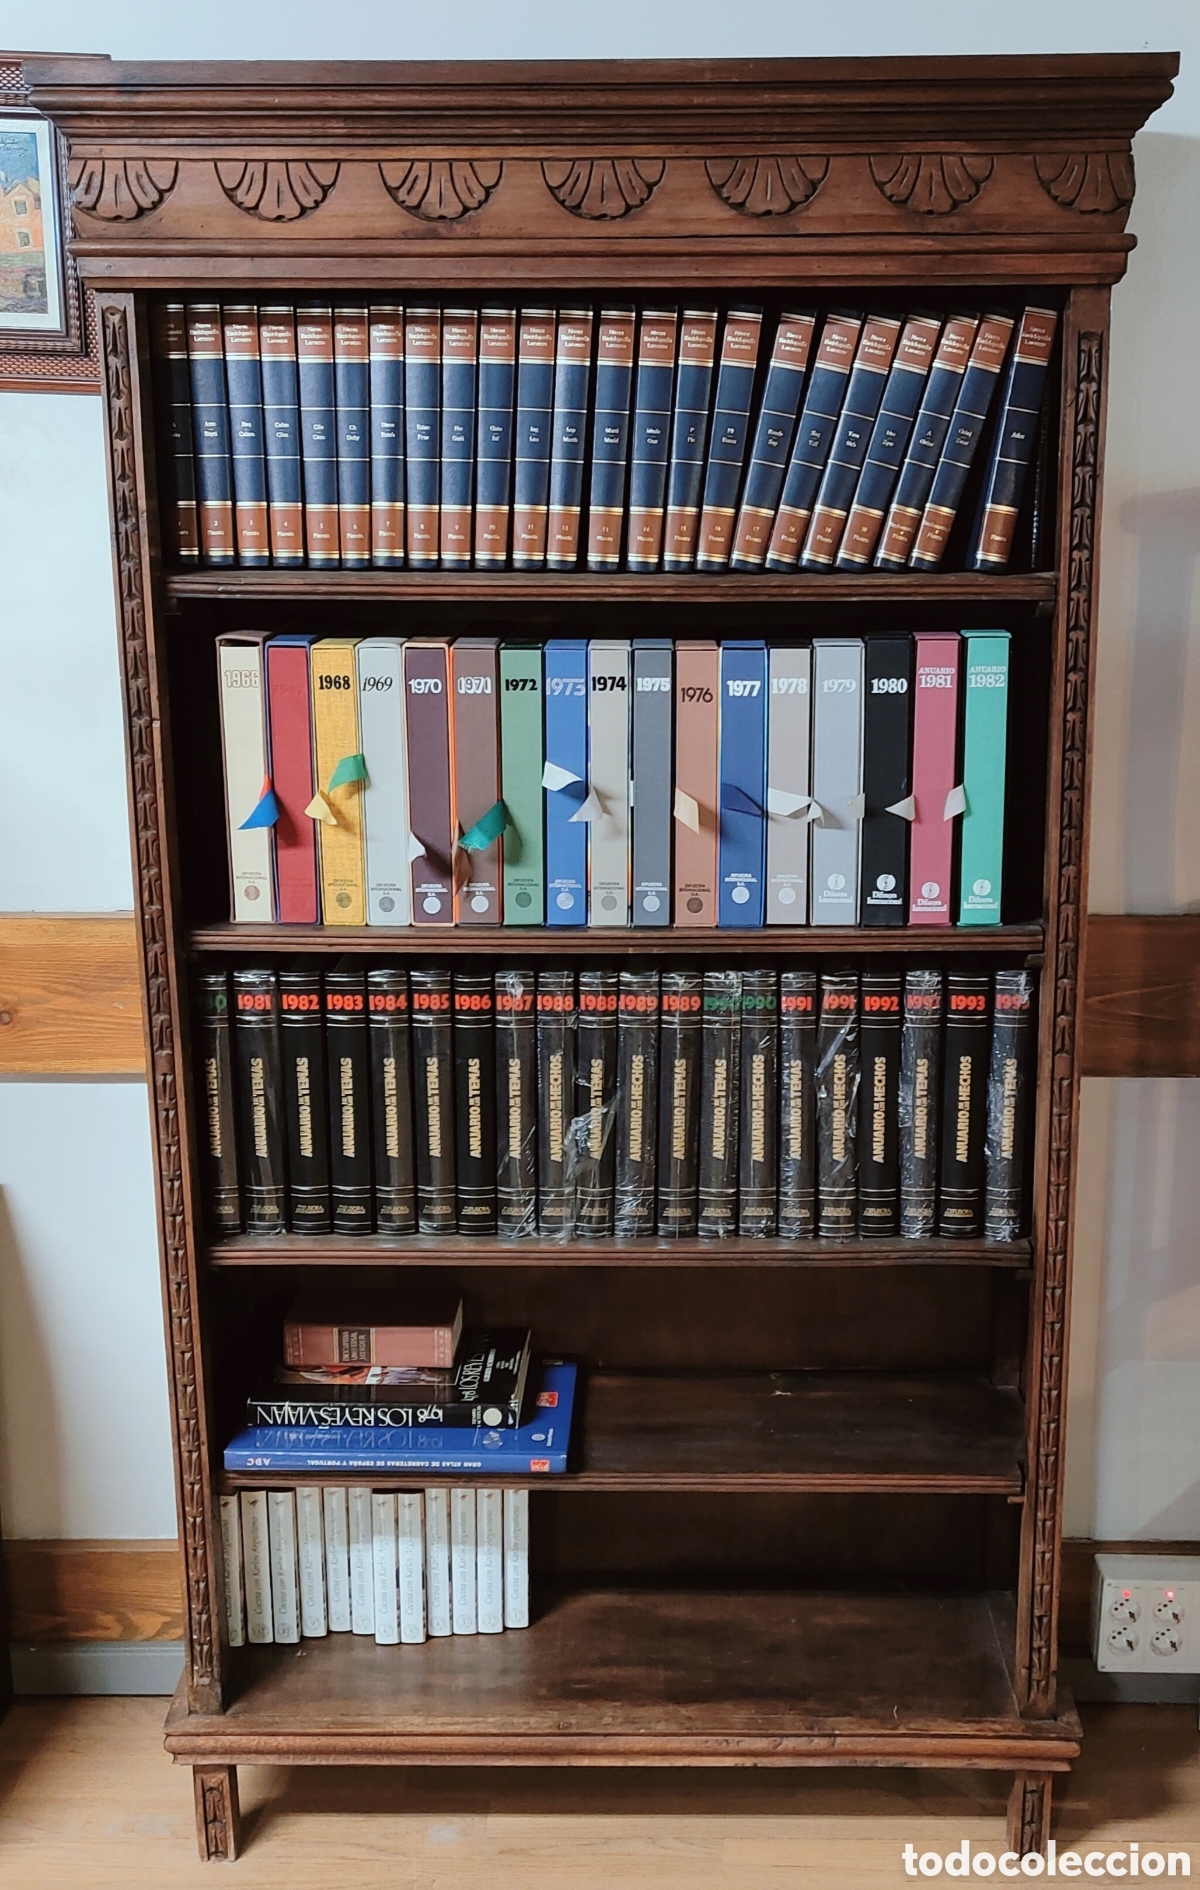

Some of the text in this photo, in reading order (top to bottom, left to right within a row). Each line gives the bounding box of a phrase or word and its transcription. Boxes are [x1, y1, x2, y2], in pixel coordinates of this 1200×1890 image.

[918, 666, 955, 675] ANUARIO
[969, 666, 1006, 674] ANUARIO
[224, 670, 260, 688] 1966
[318, 674, 350, 690] 1968
[362, 676, 393, 692] 1969
[408, 678, 442, 694] 1970
[457, 676, 492, 694] 1971
[504, 678, 538, 692] 1972
[546, 677, 586, 696] 1973
[592, 676, 627, 692] 1974
[636, 677, 671, 692] 1975
[771, 678, 808, 695] 1978
[822, 678, 857, 693] 1979
[870, 678, 908, 694] 1980
[918, 674, 953, 688] 1981
[969, 674, 1005, 688] 1982
[681, 686, 713, 703] 1976
[726, 680, 761, 697] 1977
[237, 994, 272, 1010] 1981
[282, 994, 320, 1011] 1982
[326, 994, 364, 1010] 1983
[368, 994, 408, 1011] 1984
[413, 993, 450, 1010] 1985
[454, 994, 492, 1010] 1986
[536, 994, 574, 1011] 1988
[580, 994, 617, 1012] 1988
[620, 994, 658, 1012] 1989
[662, 995, 702, 1011] 1989
[781, 994, 812, 1011] 1991
[864, 996, 900, 1012] 1992
[950, 994, 986, 1011] 1993
[591, 1059, 602, 1097] TEMAS
[251, 1057, 267, 1158] ANUARIO TEMAS
[297, 1058, 312, 1157] ANUARIO TEMAS
[340, 1058, 354, 1157] ANUARIO TEMAS
[384, 1058, 398, 1159] ANUARIO TEMAS
[426, 1058, 441, 1158] ANUARIO TEMAS
[468, 1058, 481, 1158] ANUARIO TEMAS
[509, 1058, 521, 1157] ANUARIO TEMAS
[550, 1055, 562, 1161] ANUARIO HECHOS
[630, 1054, 643, 1161] ANUARIO HECHOS
[673, 1058, 686, 1160] ANUARIO TEMAS
[713, 1058, 726, 1160] ANUARIO TEMAS
[752, 1054, 764, 1162] ANUARIO HECHOS
[790, 1060, 802, 1161] ANUARIO TEMAS
[833, 1054, 845, 1160] ANUARIO HECHOS
[873, 1057, 885, 1163] ANUARIO HECHOS
[915, 1058, 927, 1160] ANUARIO TEMAS
[957, 1056, 971, 1162] ANUARIO HECHOS
[257, 1400, 443, 1429] 1978 LOS REYES VIAJAN
[246, 1458, 271, 1466] ABC
